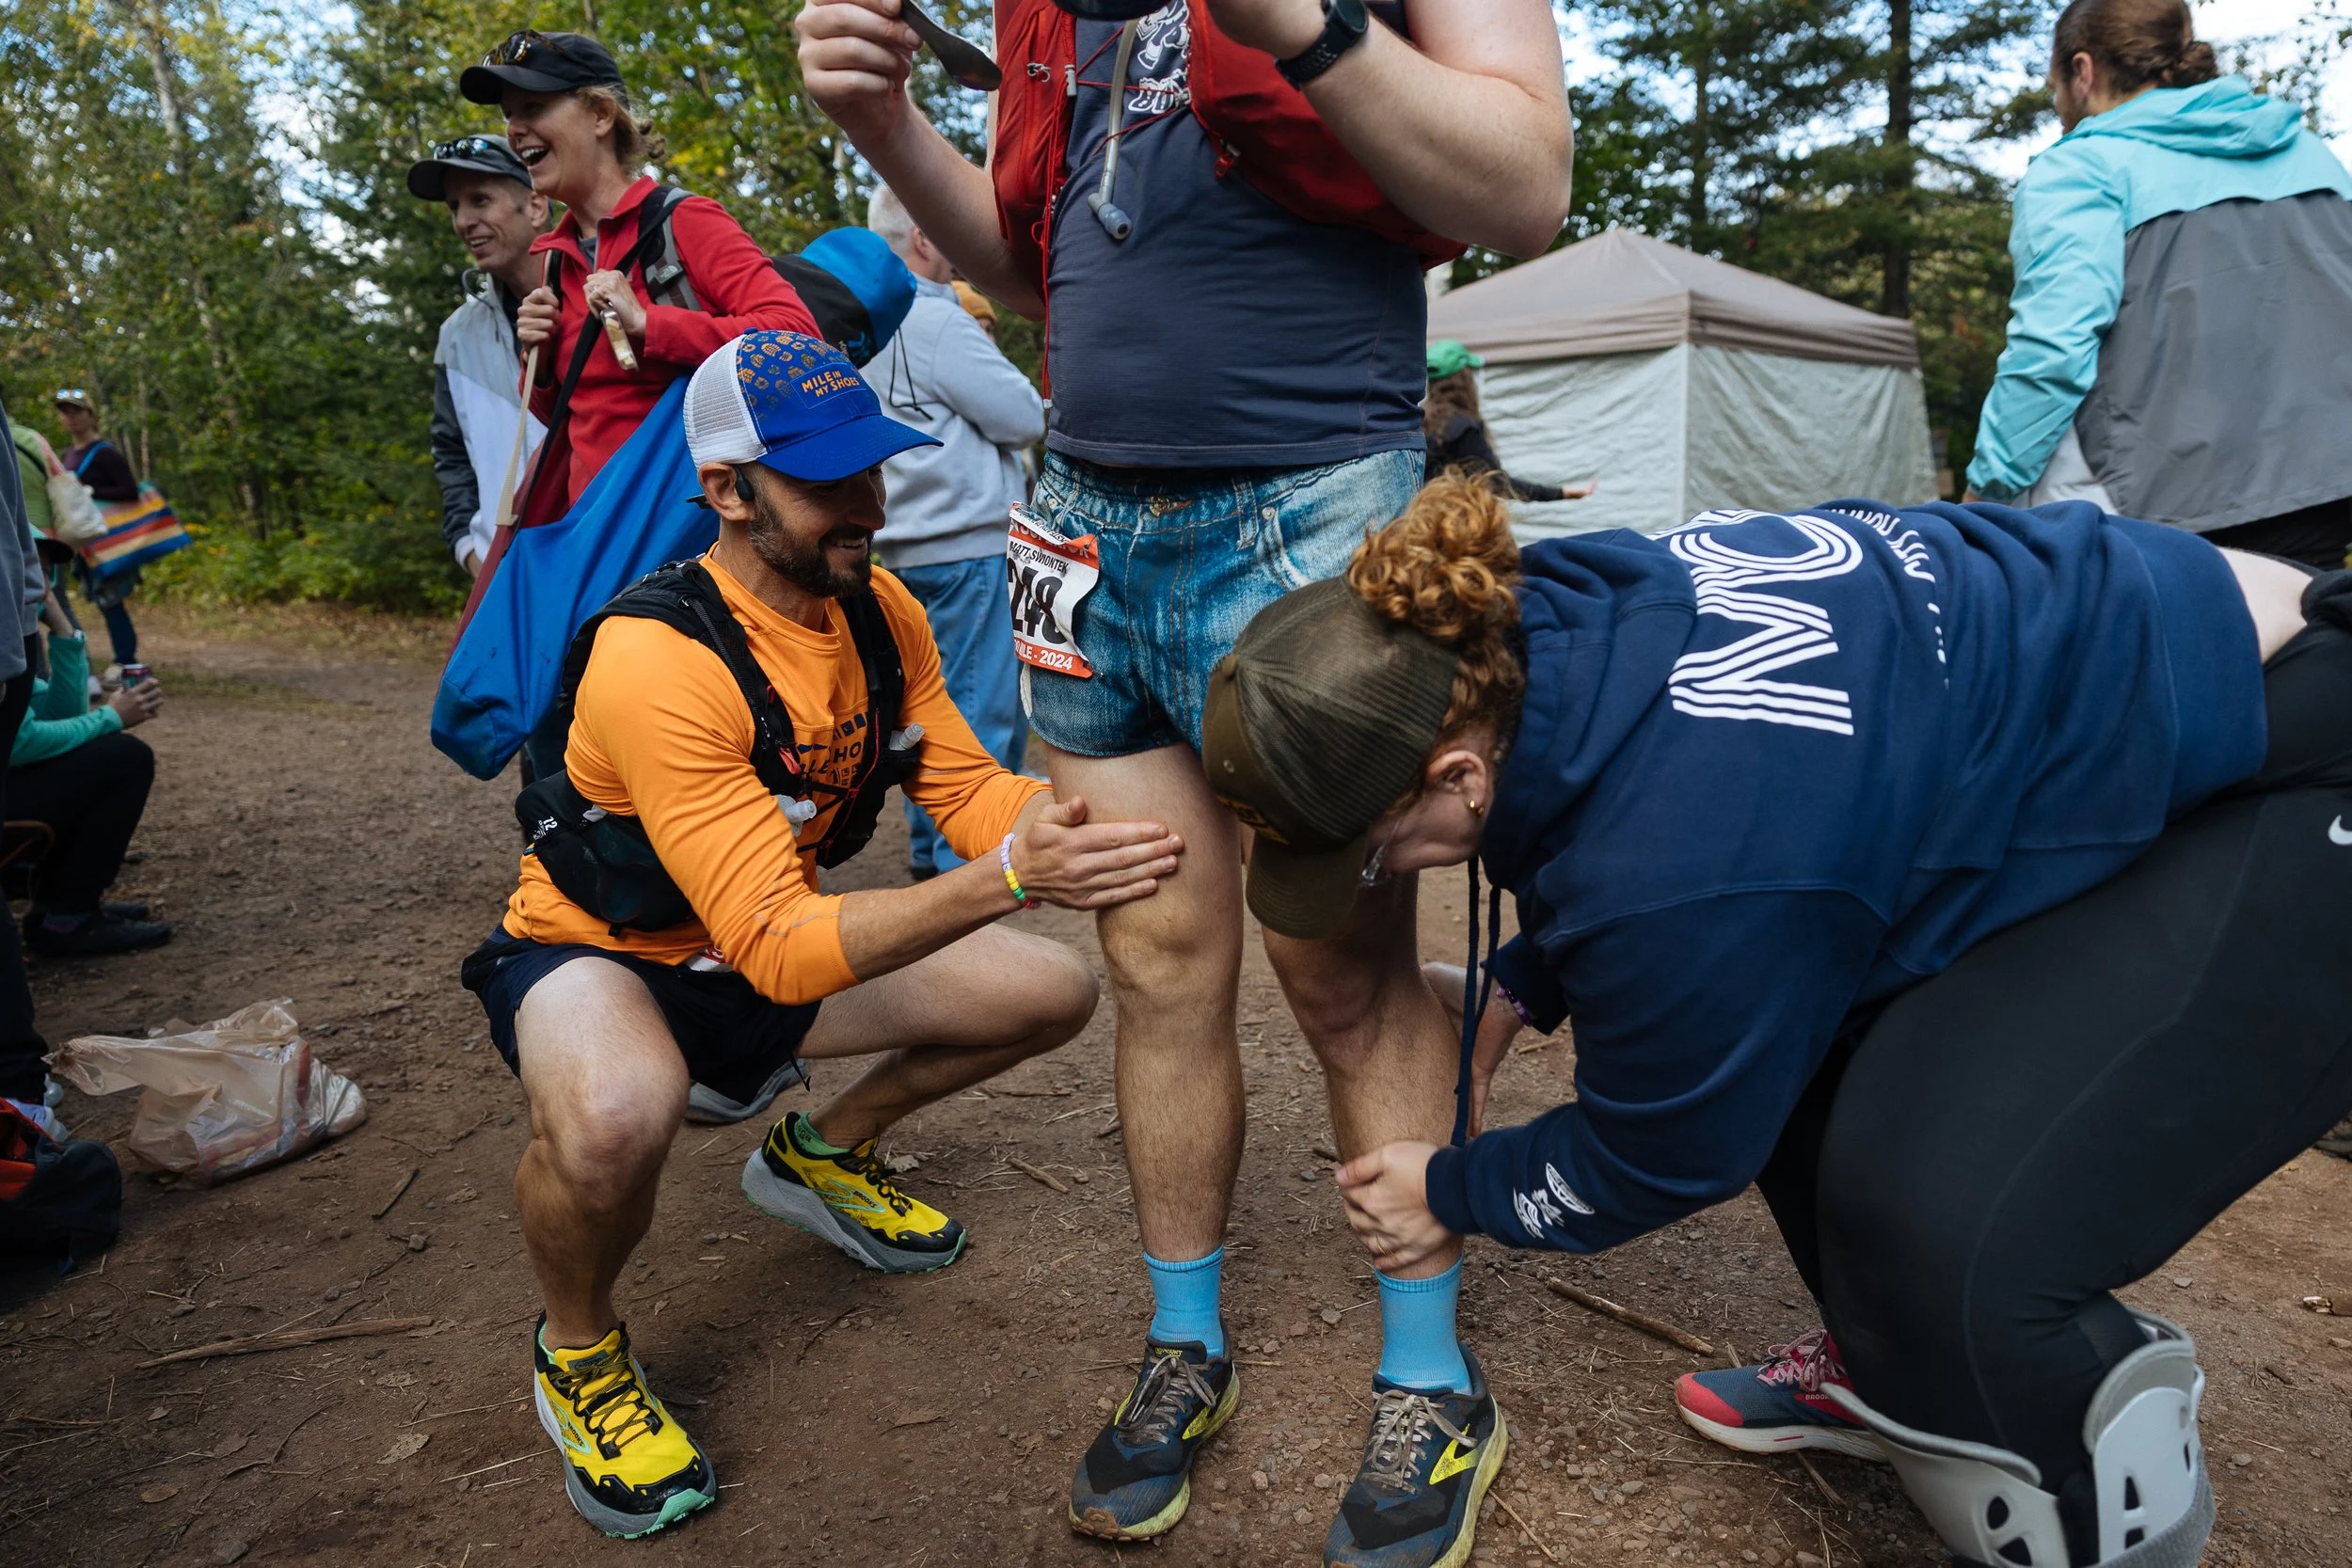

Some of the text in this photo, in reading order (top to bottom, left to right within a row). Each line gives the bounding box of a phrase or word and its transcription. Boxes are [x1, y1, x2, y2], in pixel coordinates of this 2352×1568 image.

[802, 370, 842, 393] MILE IN
[815, 377, 860, 397] MY SHOES
[1009, 541, 1031, 557] MATT
[1029, 549, 1070, 574] SWIONTEK
[1039, 649, 1073, 671] 2024
[852, 1189, 878, 1209] BROOKS
[1804, 1393, 1831, 1402] BROO
[566, 1420, 585, 1448] BROOKS
